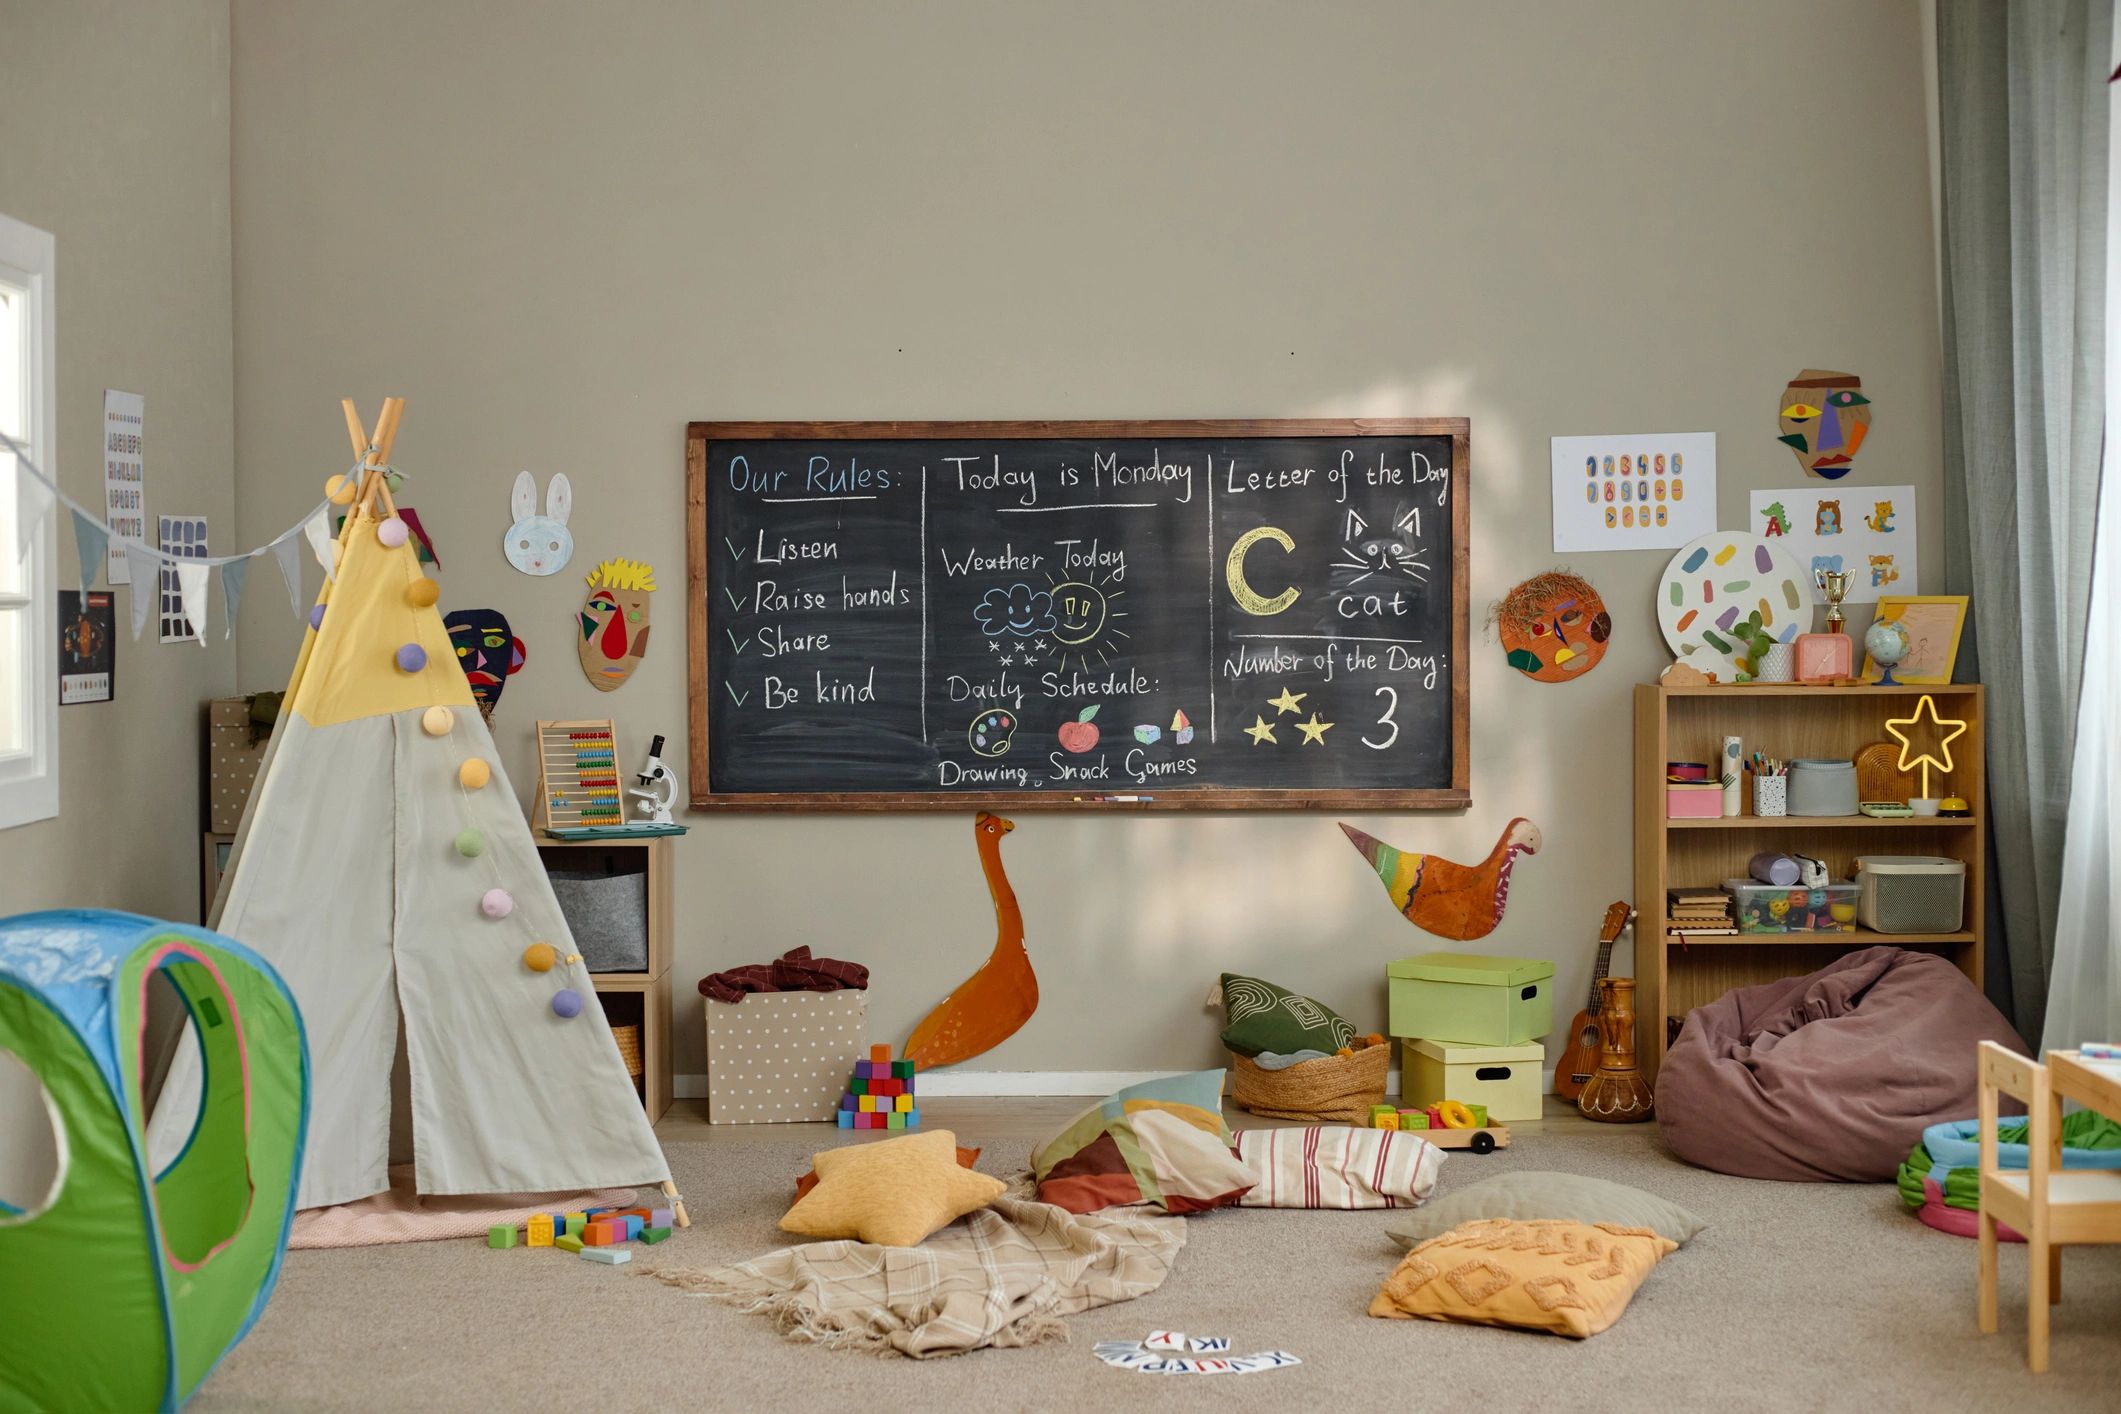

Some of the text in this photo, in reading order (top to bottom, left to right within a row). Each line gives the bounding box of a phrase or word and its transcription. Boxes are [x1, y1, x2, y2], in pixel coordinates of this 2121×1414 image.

[730, 455, 902, 492] Our Rules:
[941, 447, 1192, 506] Today is Monday
[1226, 449, 1449, 506] Letter of the Day
[1586, 453, 1682, 477] 1 2 3 4 5 6
[1587, 481, 1598, 503] 7
[1604, 480, 1615, 502] 8
[1621, 480, 1632, 502] 9
[755, 528, 839, 564] Listen
[1765, 516, 1783, 537] A
[941, 538, 1126, 582] Weather Today
[1226, 526, 1301, 616] C
[755, 570, 910, 613] Raise hands
[1338, 592, 1408, 618] cat
[758, 626, 831, 657] Share
[765, 666, 876, 709] Be kind
[947, 666, 1160, 709] Daily Schedule:
[1224, 643, 1447, 690] Number of the Day:
[1361, 686, 1400, 749] 3
[938, 748, 1197, 787] Drawing Snack Games
